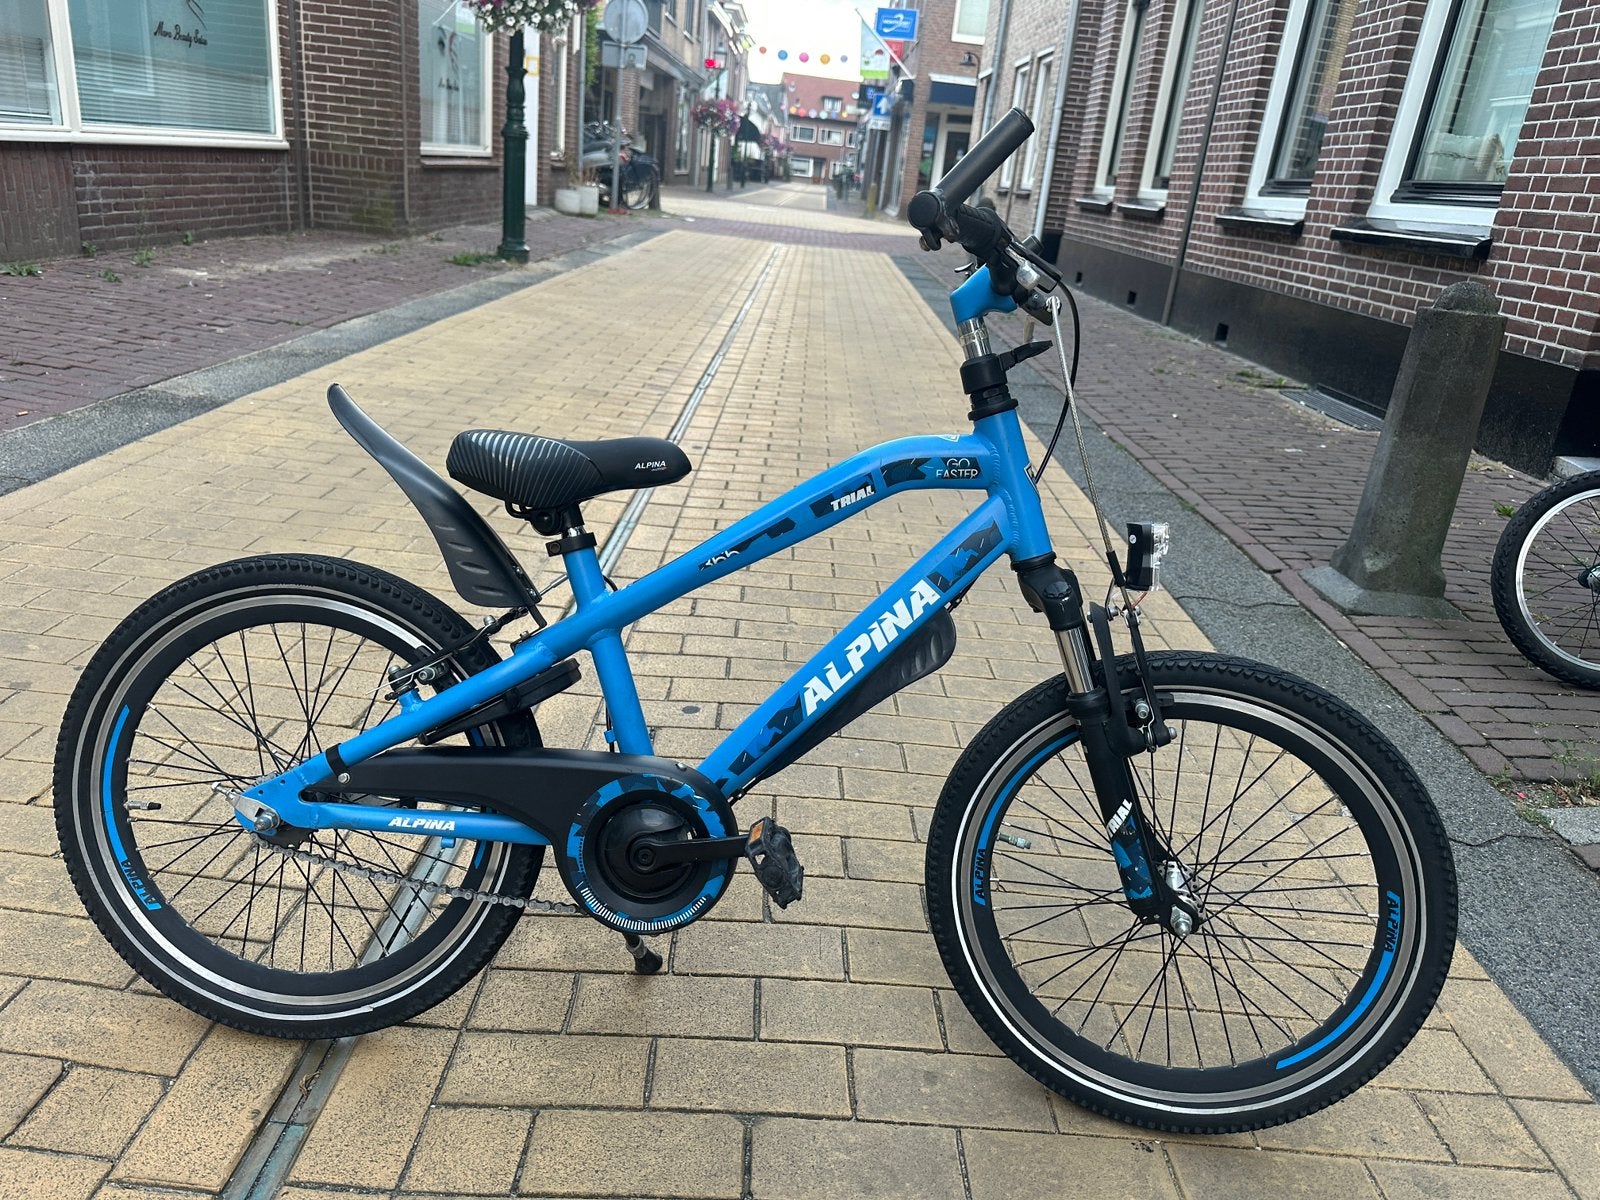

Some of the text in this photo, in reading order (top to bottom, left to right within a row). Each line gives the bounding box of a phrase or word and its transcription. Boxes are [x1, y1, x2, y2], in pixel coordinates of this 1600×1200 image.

[634, 460, 666, 470] ALPINA
[830, 485, 875, 512] TRIAL
[803, 579, 941, 717] ALPINA
[388, 816, 456, 831] ALPINA
[1106, 798, 1133, 839] TRIAL
[120, 859, 158, 905] ALPINA
[973, 848, 986, 899] ALPINA
[1384, 897, 1400, 953] ALPINA
